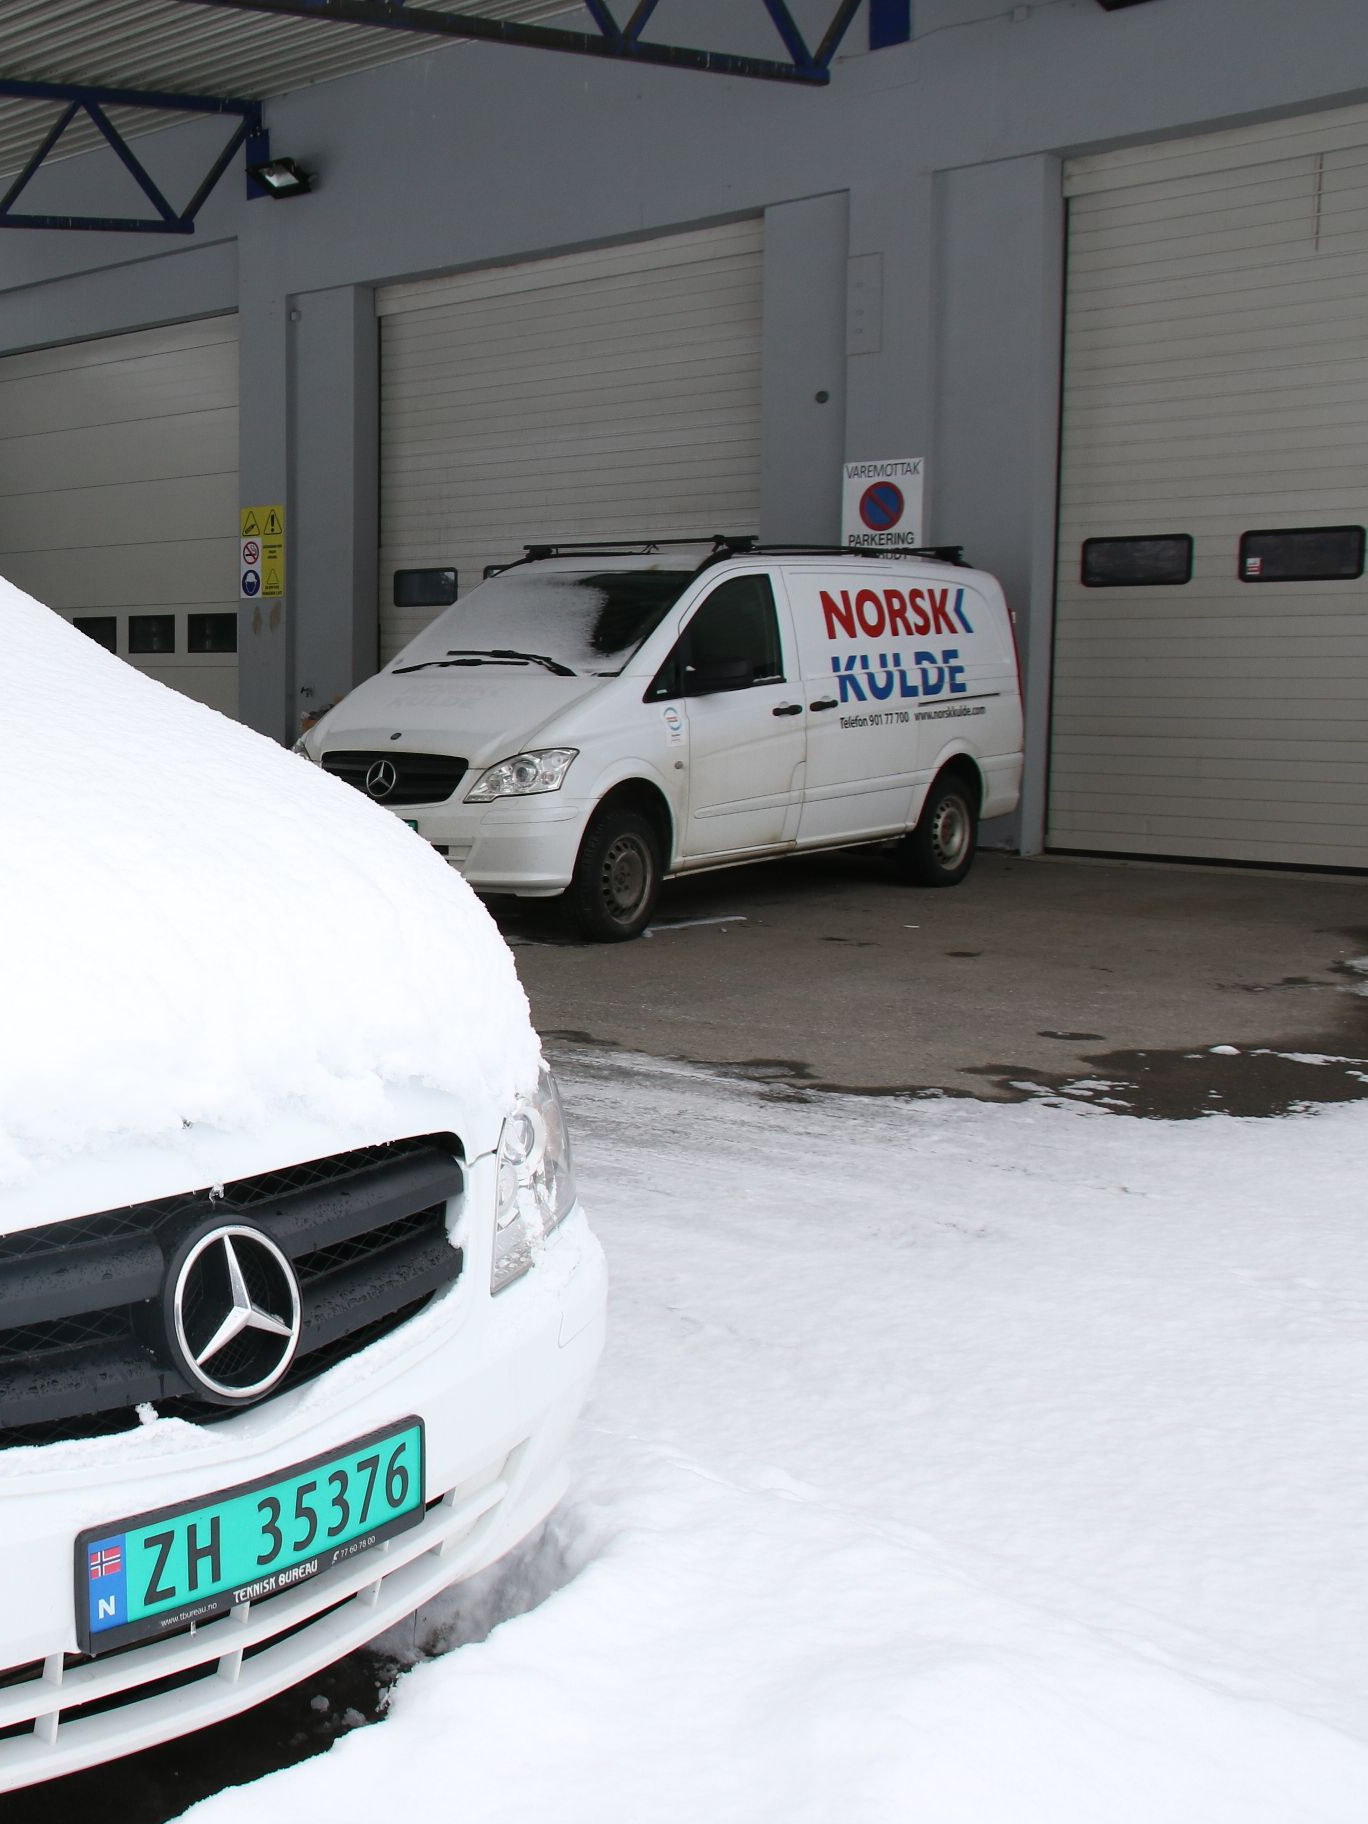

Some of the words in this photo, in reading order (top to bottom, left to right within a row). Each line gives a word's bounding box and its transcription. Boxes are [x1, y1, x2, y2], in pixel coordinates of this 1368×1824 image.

[846, 461, 921, 479] VAREMOTTAK
[848, 532, 915, 547] PARKERING
[819, 588, 958, 640] NORSK
[831, 649, 967, 703] KULDE
[840, 716, 868, 729] Telefon
[869, 713, 882, 727] 901
[884, 712, 894, 725] 77
[896, 711, 909, 724] 700
[143, 1517, 221, 1606] ZH
[256, 1442, 410, 1566] 35376
[340, 1548, 348, 1558] 77
[349, 1543, 358, 1554] 60
[359, 1539, 367, 1549] 78
[367, 1535, 376, 1546] 00
[233, 1576, 276, 1603] TEKNISK
[278, 1559, 318, 1586] BUREAU
[98, 1594, 116, 1619] N
[160, 1601, 218, 1627] www.tbureau.no
